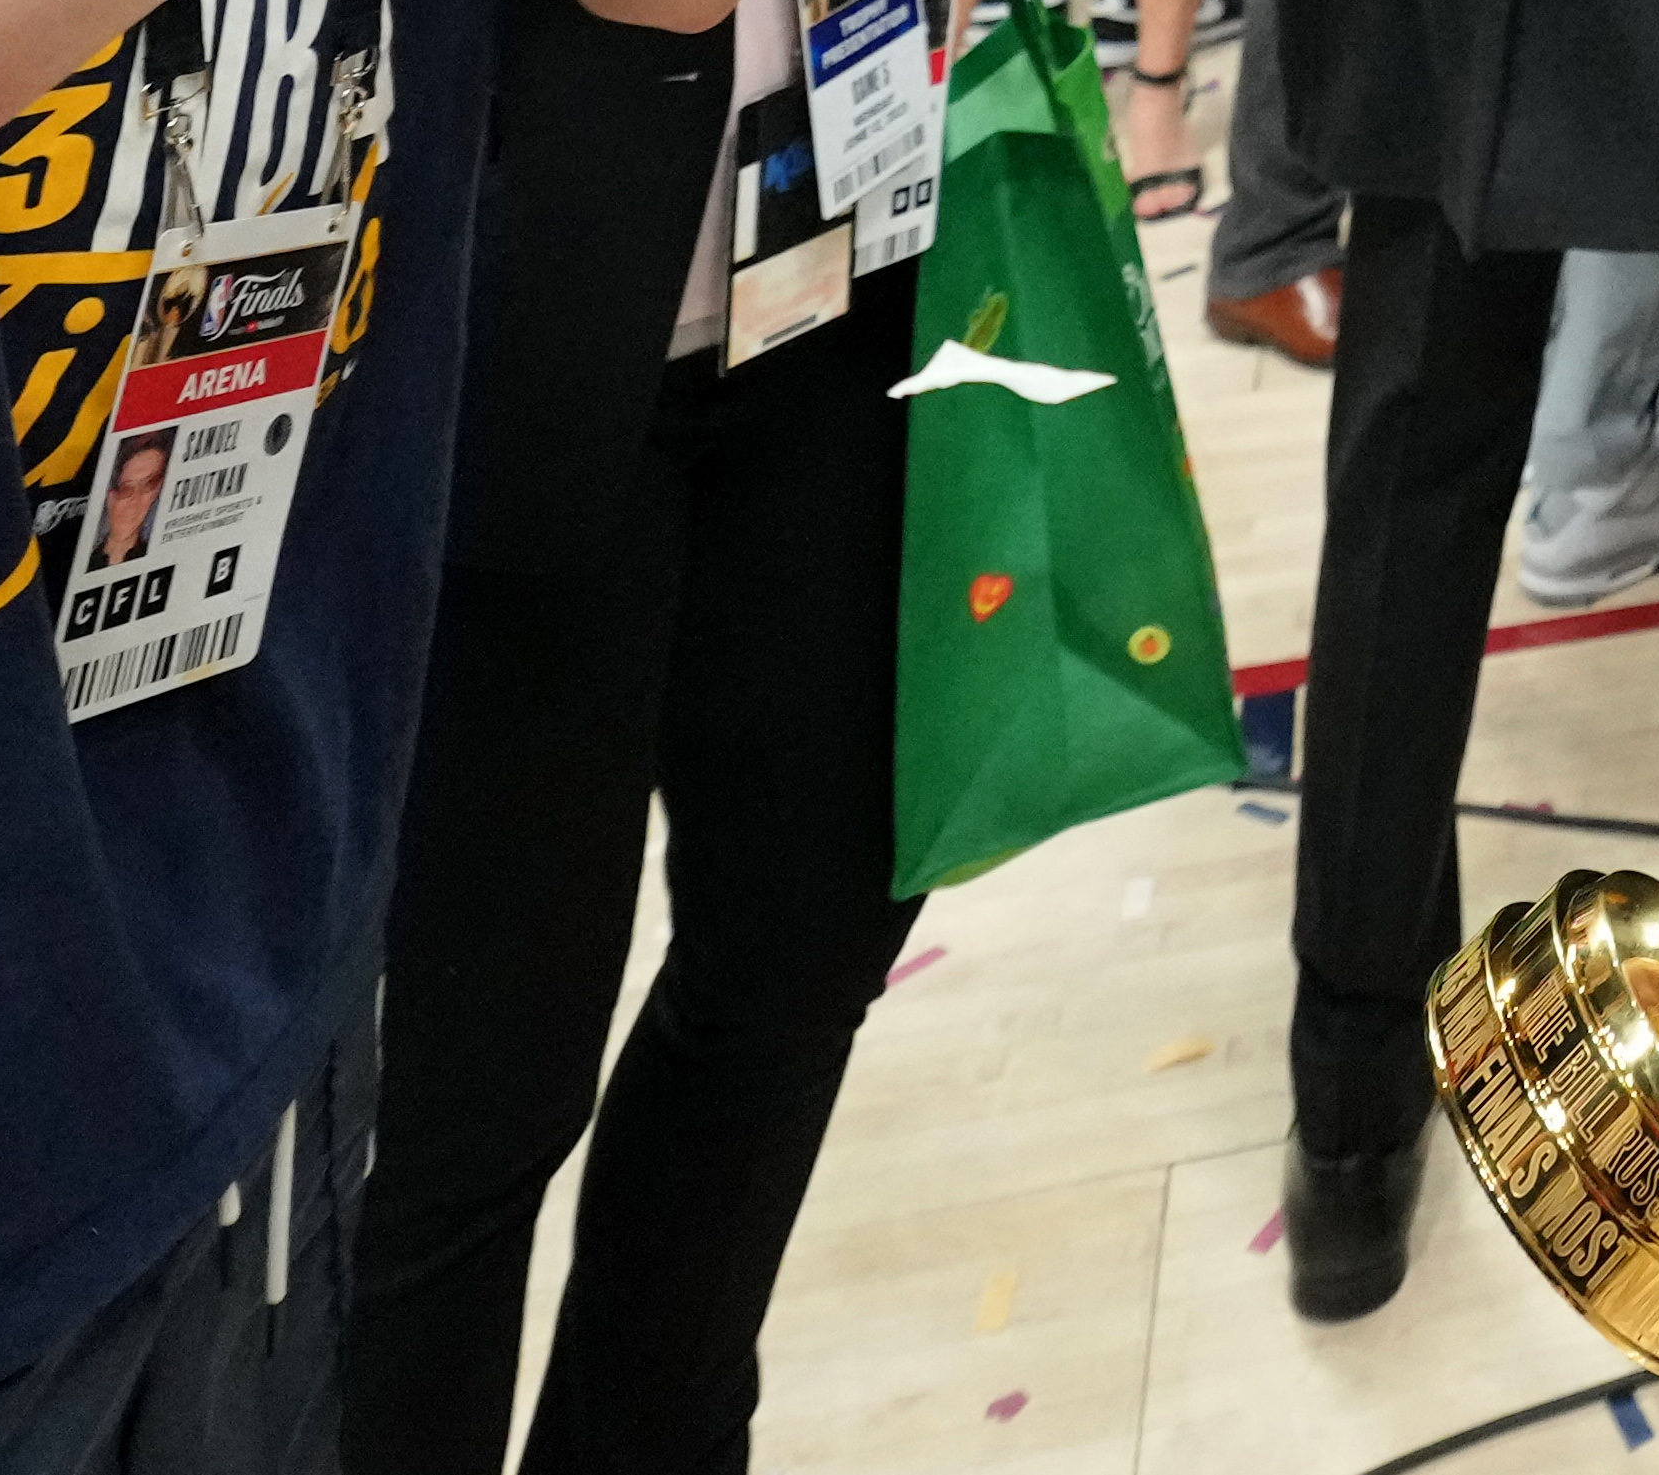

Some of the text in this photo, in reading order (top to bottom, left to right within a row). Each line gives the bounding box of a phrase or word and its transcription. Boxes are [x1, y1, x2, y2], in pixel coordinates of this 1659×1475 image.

[207, 266, 306, 342] Finals
[175, 357, 269, 405] ARENA
[182, 419, 244, 463] SAMUEL
[212, 555, 233, 584] B
[74, 577, 162, 626] C F L
[1548, 1039, 1619, 1143] BILL
[1459, 1044, 1559, 1198] FINALS
[1523, 1162, 1640, 1297] MOST
